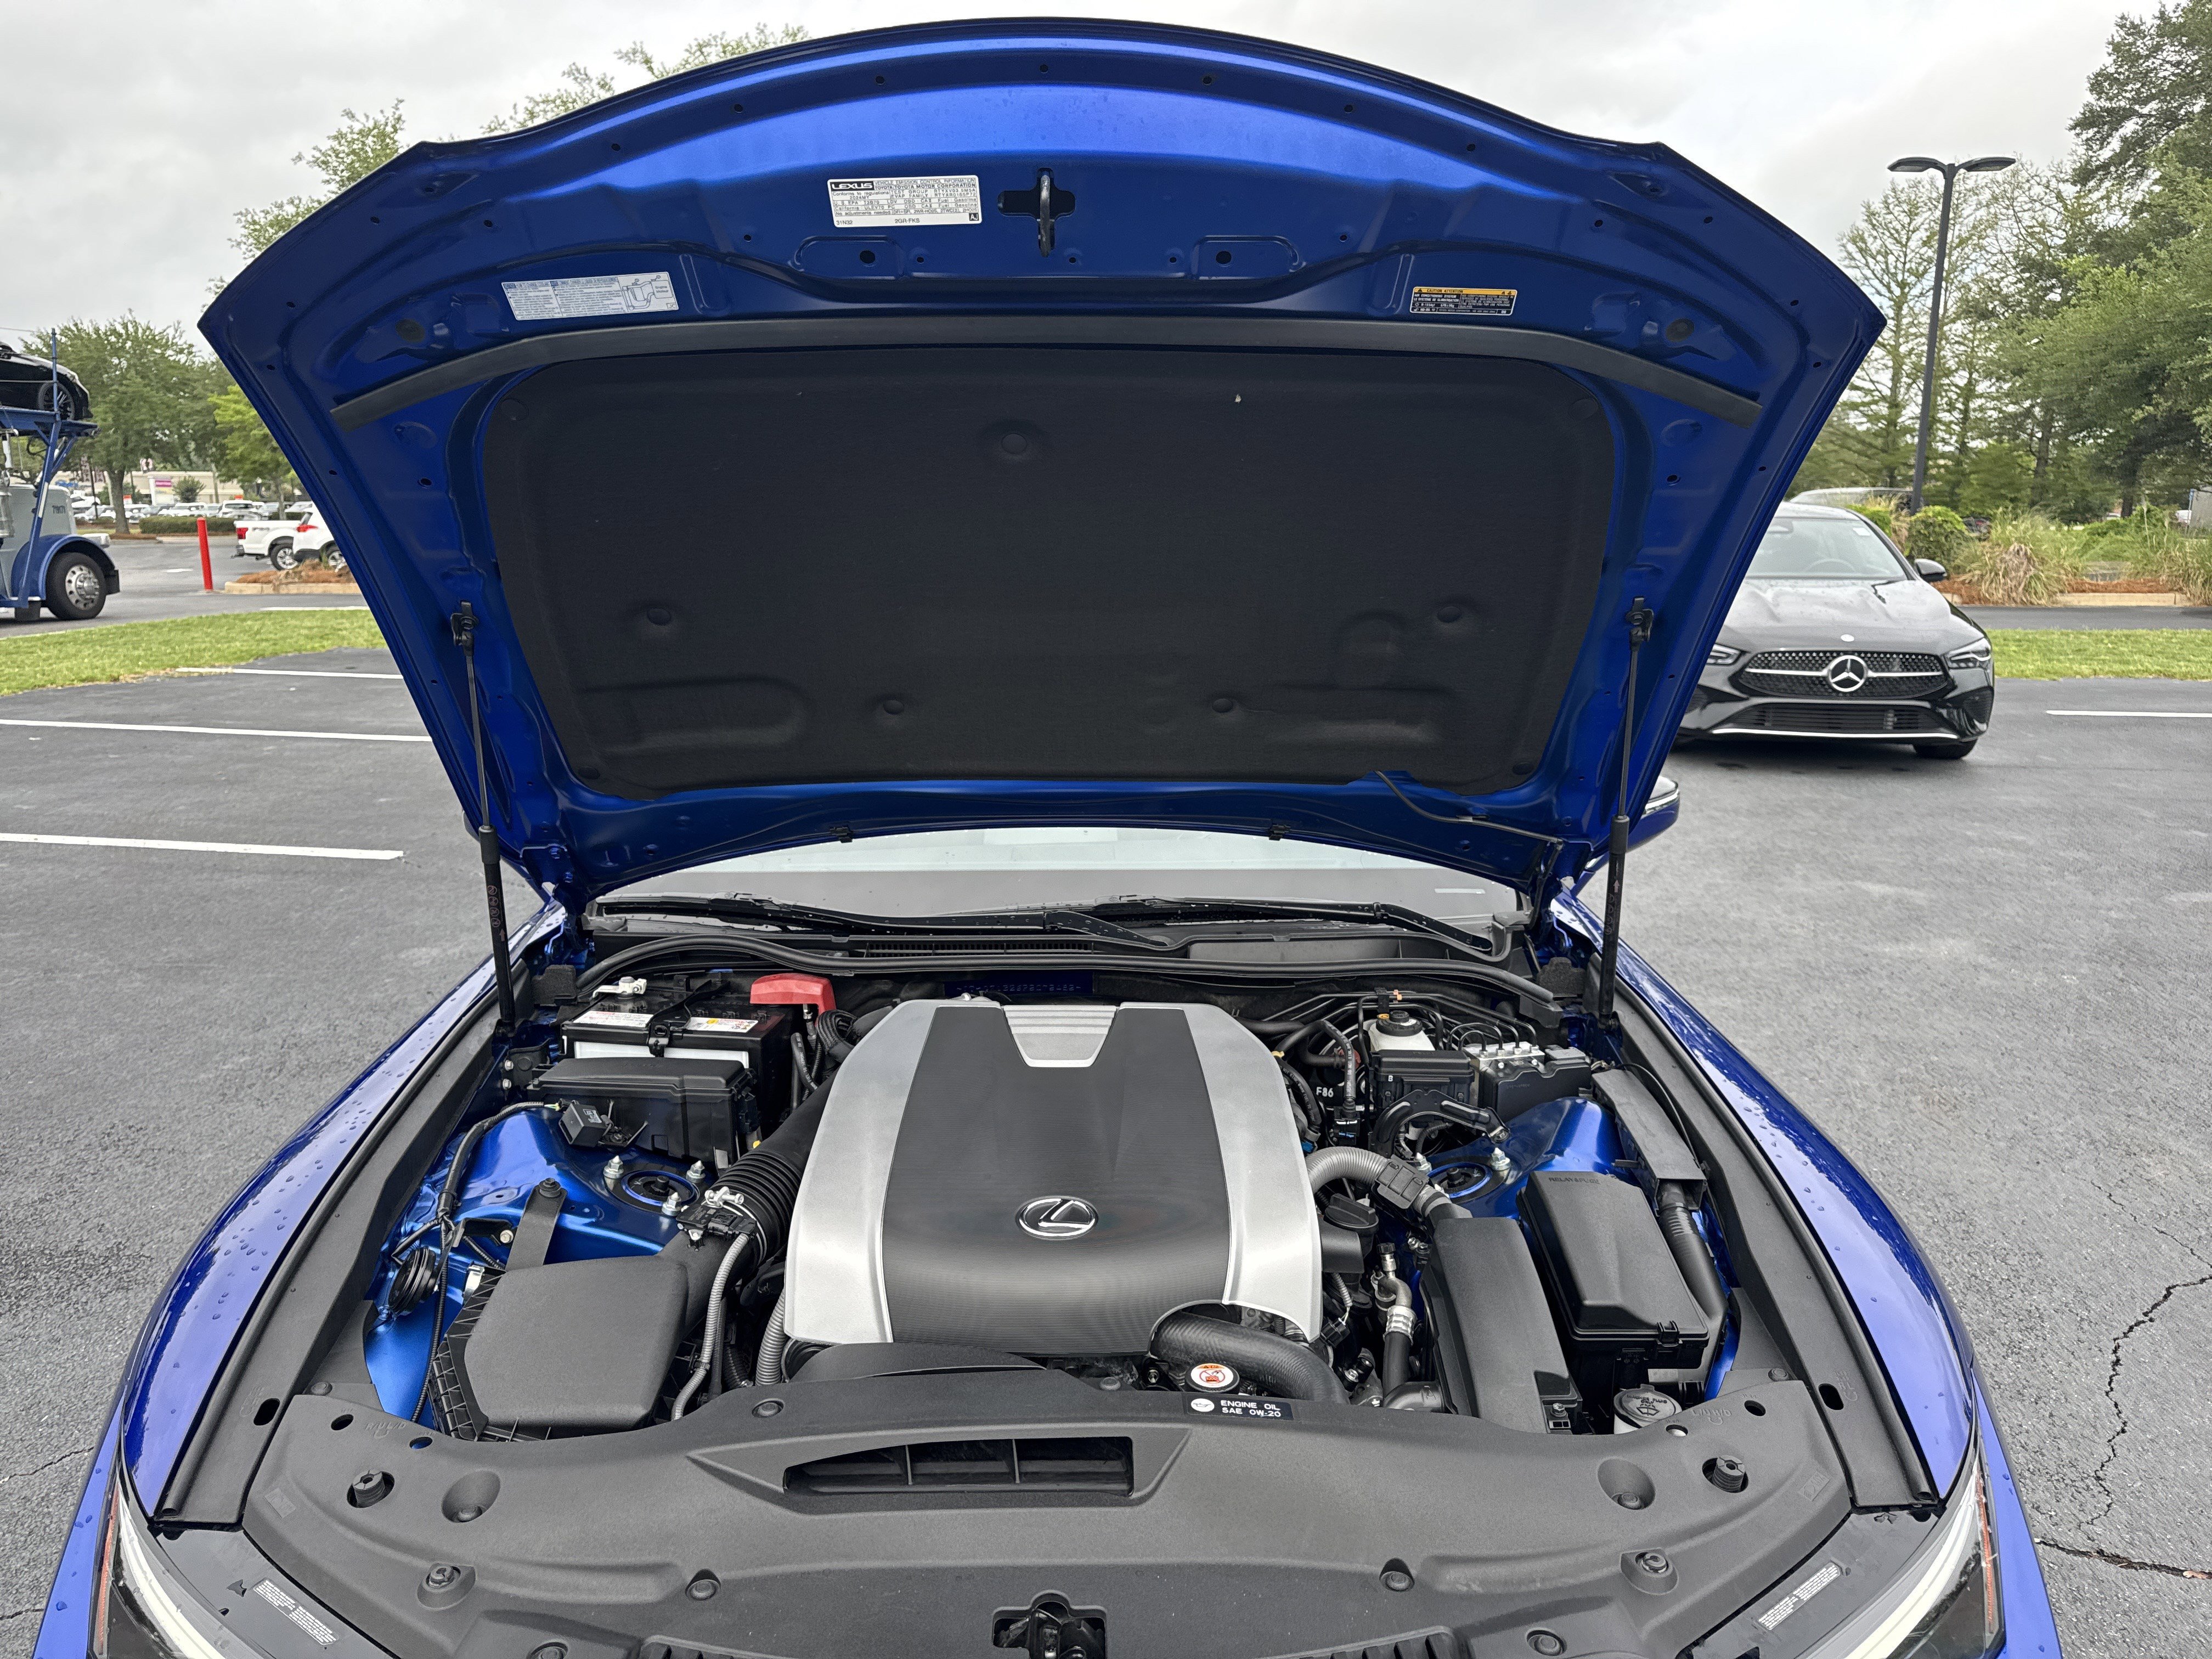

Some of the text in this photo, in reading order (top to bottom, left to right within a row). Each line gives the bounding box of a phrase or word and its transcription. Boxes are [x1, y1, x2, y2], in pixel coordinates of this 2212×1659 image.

[1316, 1086, 1334, 1097] F86
[1221, 1400, 1257, 1409] ENGINE
[1249, 1409, 1282, 1417] 0W-20
